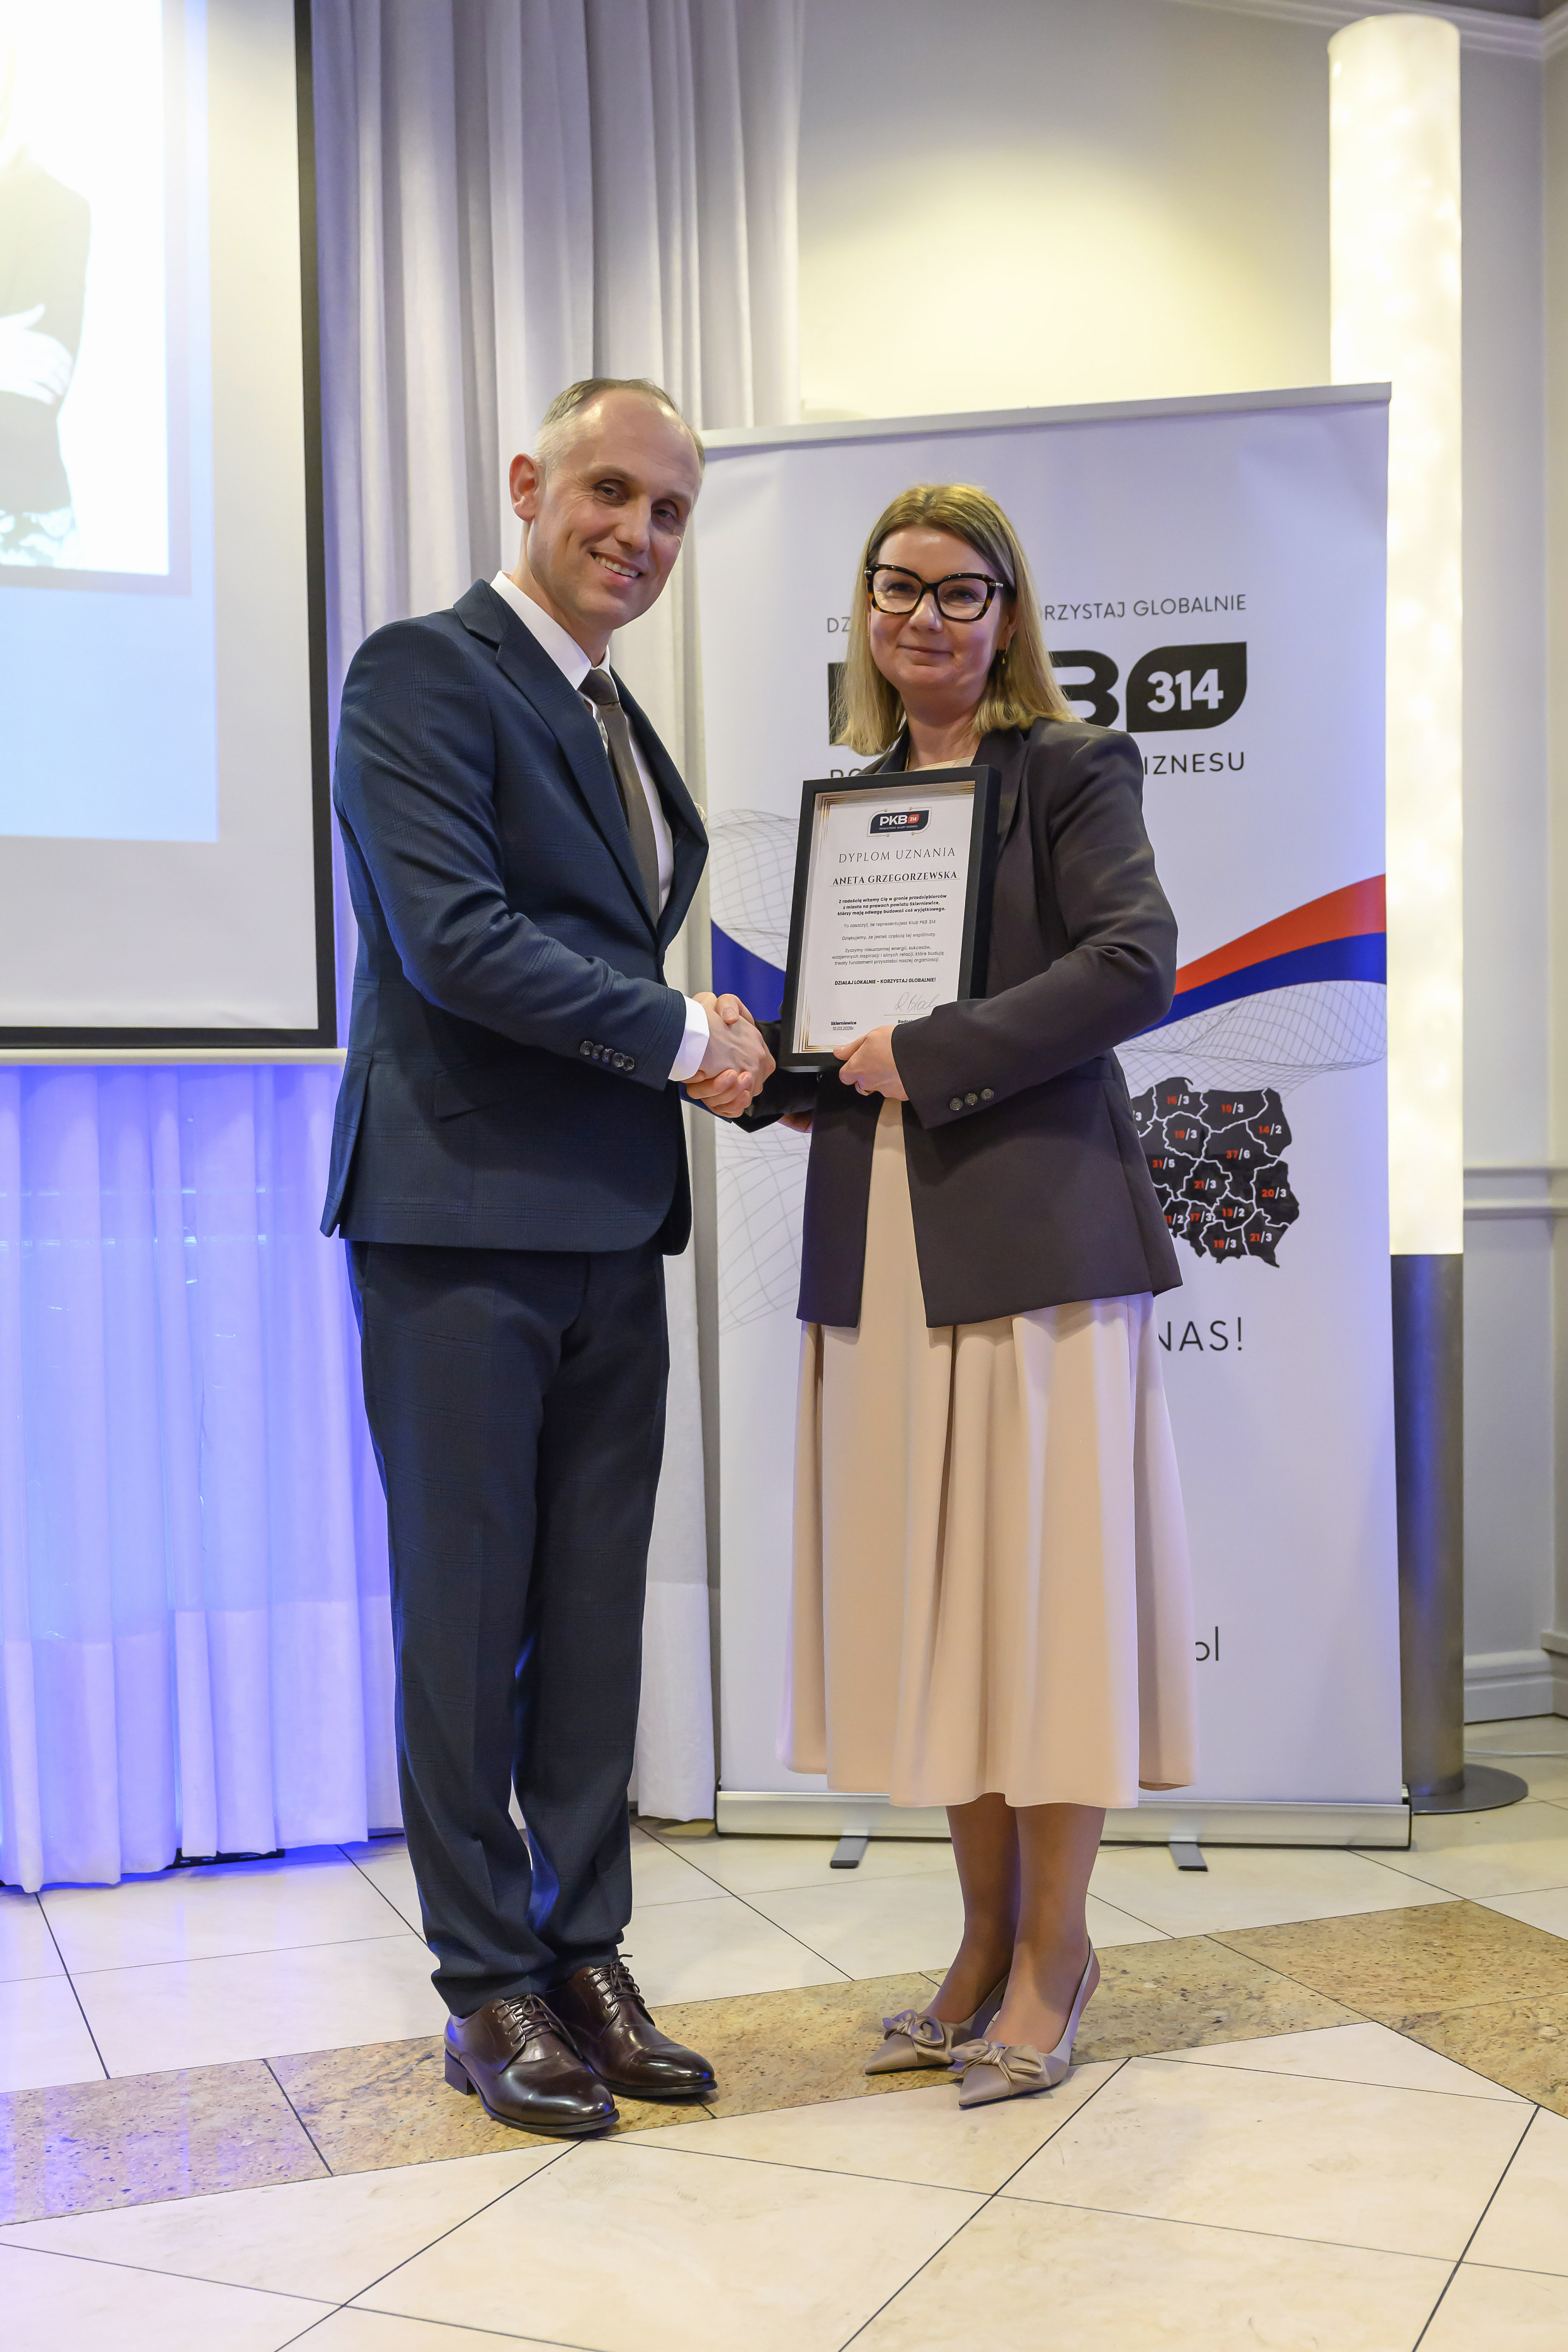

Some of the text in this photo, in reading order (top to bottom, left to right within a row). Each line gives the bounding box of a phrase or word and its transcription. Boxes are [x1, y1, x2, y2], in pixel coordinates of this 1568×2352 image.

[1044, 601, 1125, 621] RZYSTAJ
[1133, 594, 1247, 616] GLOBALNIE
[1147, 669, 1224, 713] 314
[1145, 751, 1244, 775] IZNESU
[879, 815, 908, 826] PKB
[839, 847, 955, 863] DYPLOM UZNANIA
[833, 871, 957, 885] ANETA GRZEGORZEWSKA
[1258, 1123, 1282, 1135] 14/2
[1194, 1178, 1217, 1190] 21/3
[1262, 1187, 1286, 1199] 20/3
[1190, 1210, 1212, 1223] 17/3
